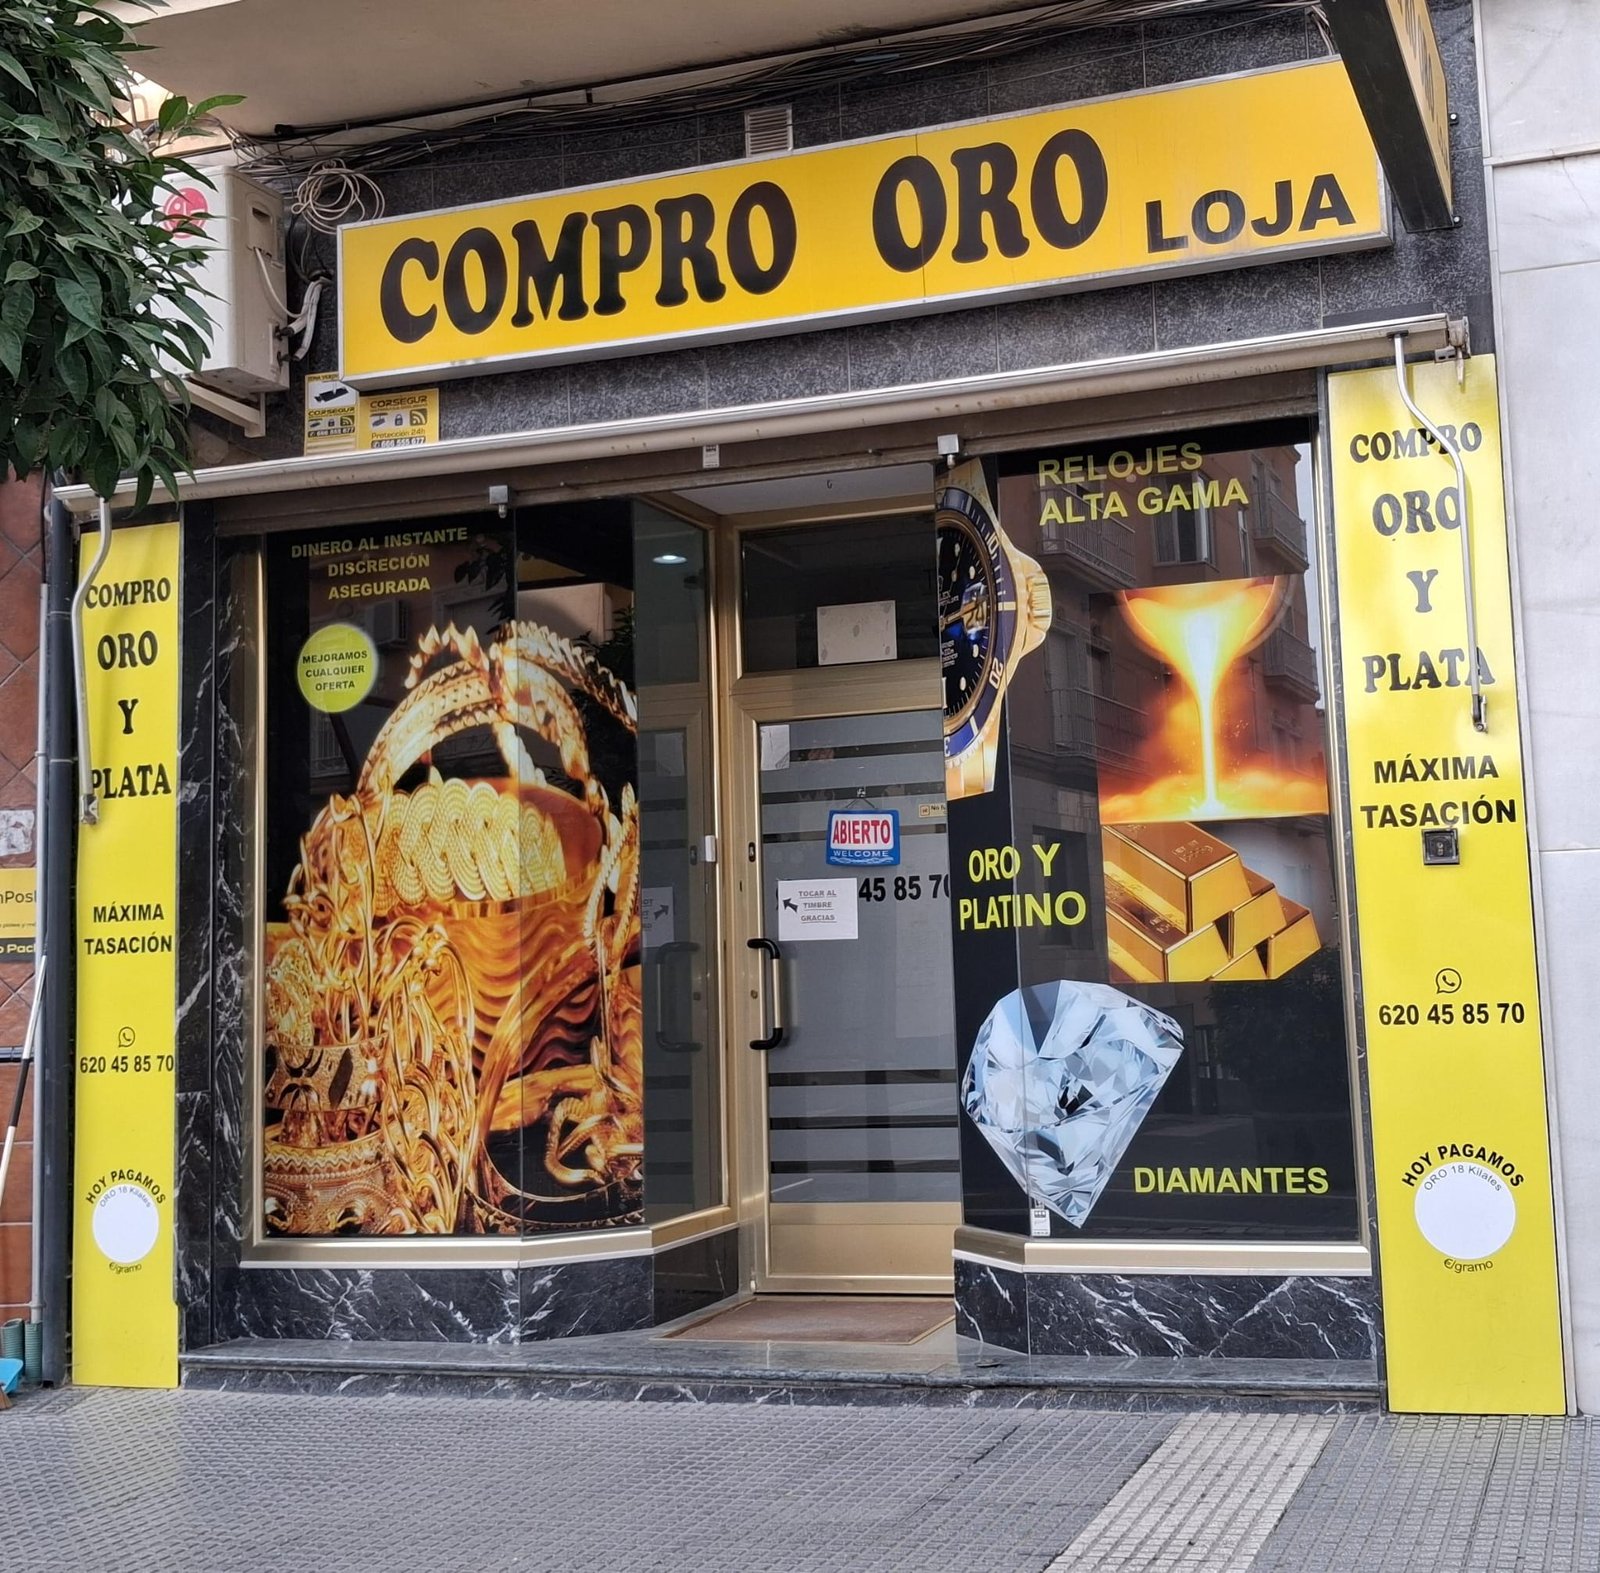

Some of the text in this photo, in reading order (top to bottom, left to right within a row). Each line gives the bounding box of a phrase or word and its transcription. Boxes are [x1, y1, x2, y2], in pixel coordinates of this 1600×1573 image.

[1146, 174, 1356, 253] LOJA
[380, 129, 1108, 344] COMPRO ORO
[370, 395, 427, 408] CORSEGUR
[1350, 422, 1482, 463] COMPRO
[1038, 442, 1203, 487] RELOJES
[1039, 478, 1250, 526] ALTA GAMA
[1372, 487, 1461, 536] ORO
[291, 527, 468, 558] DINERO AL INSTANTE
[328, 552, 430, 577] DISCRECIÓN
[85, 577, 171, 609] COMPRO
[328, 576, 431, 600] ASEGURADA
[1406, 569, 1439, 613] Y
[97, 630, 158, 670] ORO
[302, 650, 368, 664] MEJORAMOS
[305, 665, 365, 678] CUALQUIER
[1362, 647, 1495, 693] PLATA
[315, 680, 355, 691] OFERTA
[117, 698, 139, 735] Y
[91, 763, 171, 799] PLATA
[1373, 754, 1499, 784] MÁXIMA
[1360, 795, 1517, 828] TASACIÓN
[832, 819, 891, 845] ABIERTO
[833, 850, 889, 858] WELCOME
[968, 843, 1061, 883] ORO Y
[858, 877, 886, 902] 45
[893, 875, 921, 901] 85
[93, 901, 164, 923] MÁXIMA
[801, 914, 836, 922] GRACIAS
[803, 901, 832, 909] TIMBRE
[959, 890, 1087, 930] PLATINO
[84, 932, 172, 955] TASACIÓN
[1378, 1003, 1525, 1026] 620 45 85 70
[80, 1054, 174, 1073] 620 45 85 70
[1401, 1143, 1524, 1187] HOY PAGAMOS
[1424, 1165, 1502, 1191] ORO 18 Kilates
[86, 1169, 167, 1204] HOY PAGAMOS
[1133, 1167, 1329, 1194] DIAMANTES
